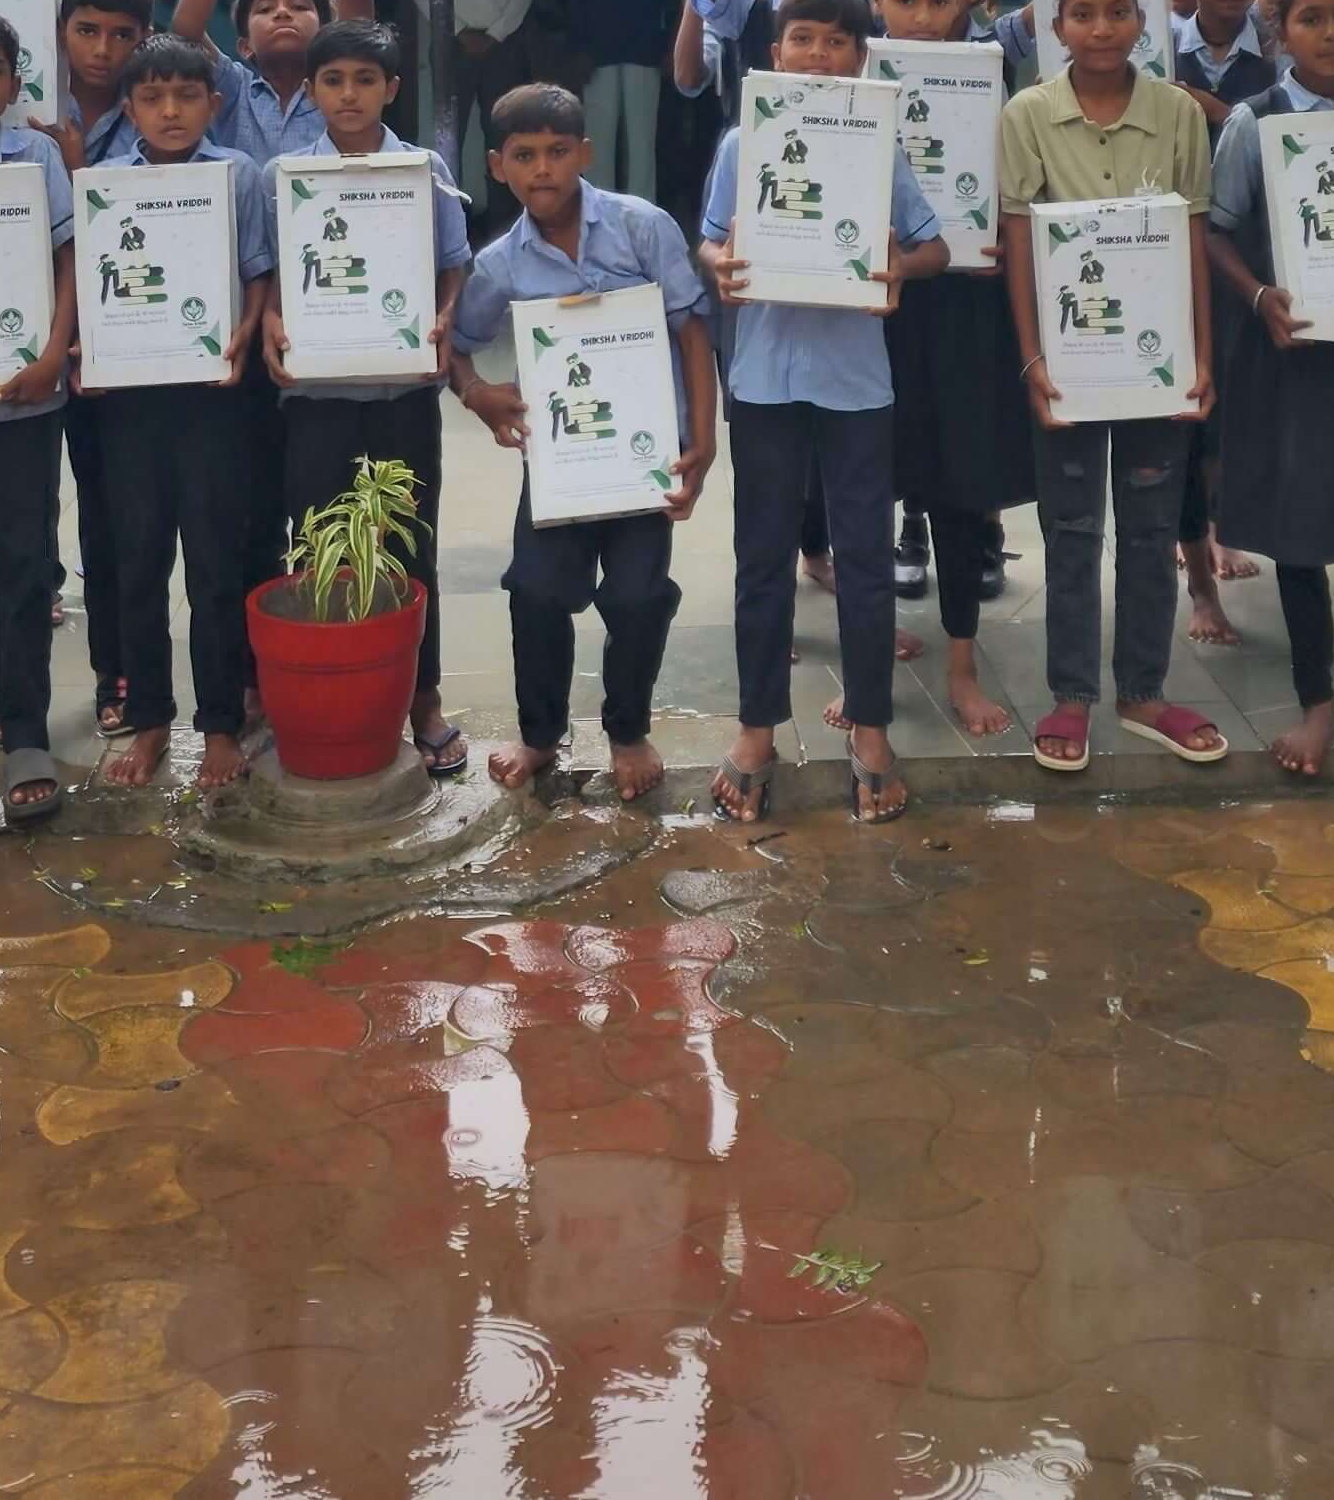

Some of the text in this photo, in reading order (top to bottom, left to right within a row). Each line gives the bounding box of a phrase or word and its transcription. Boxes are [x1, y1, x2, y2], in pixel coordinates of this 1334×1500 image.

[923, 77, 992, 89] SHIKSHA VRIDDHI
[802, 116, 877, 129] SHIKSHA VRIDDHI
[339, 191, 414, 201] SHIKSHA VRIDDHI
[136, 198, 211, 211] SHIKSHA VRIDDHI
[1096, 233, 1170, 245] SHIKSHA VRIDDHI
[581, 331, 654, 347] SHIKSHA VRIDDHI
